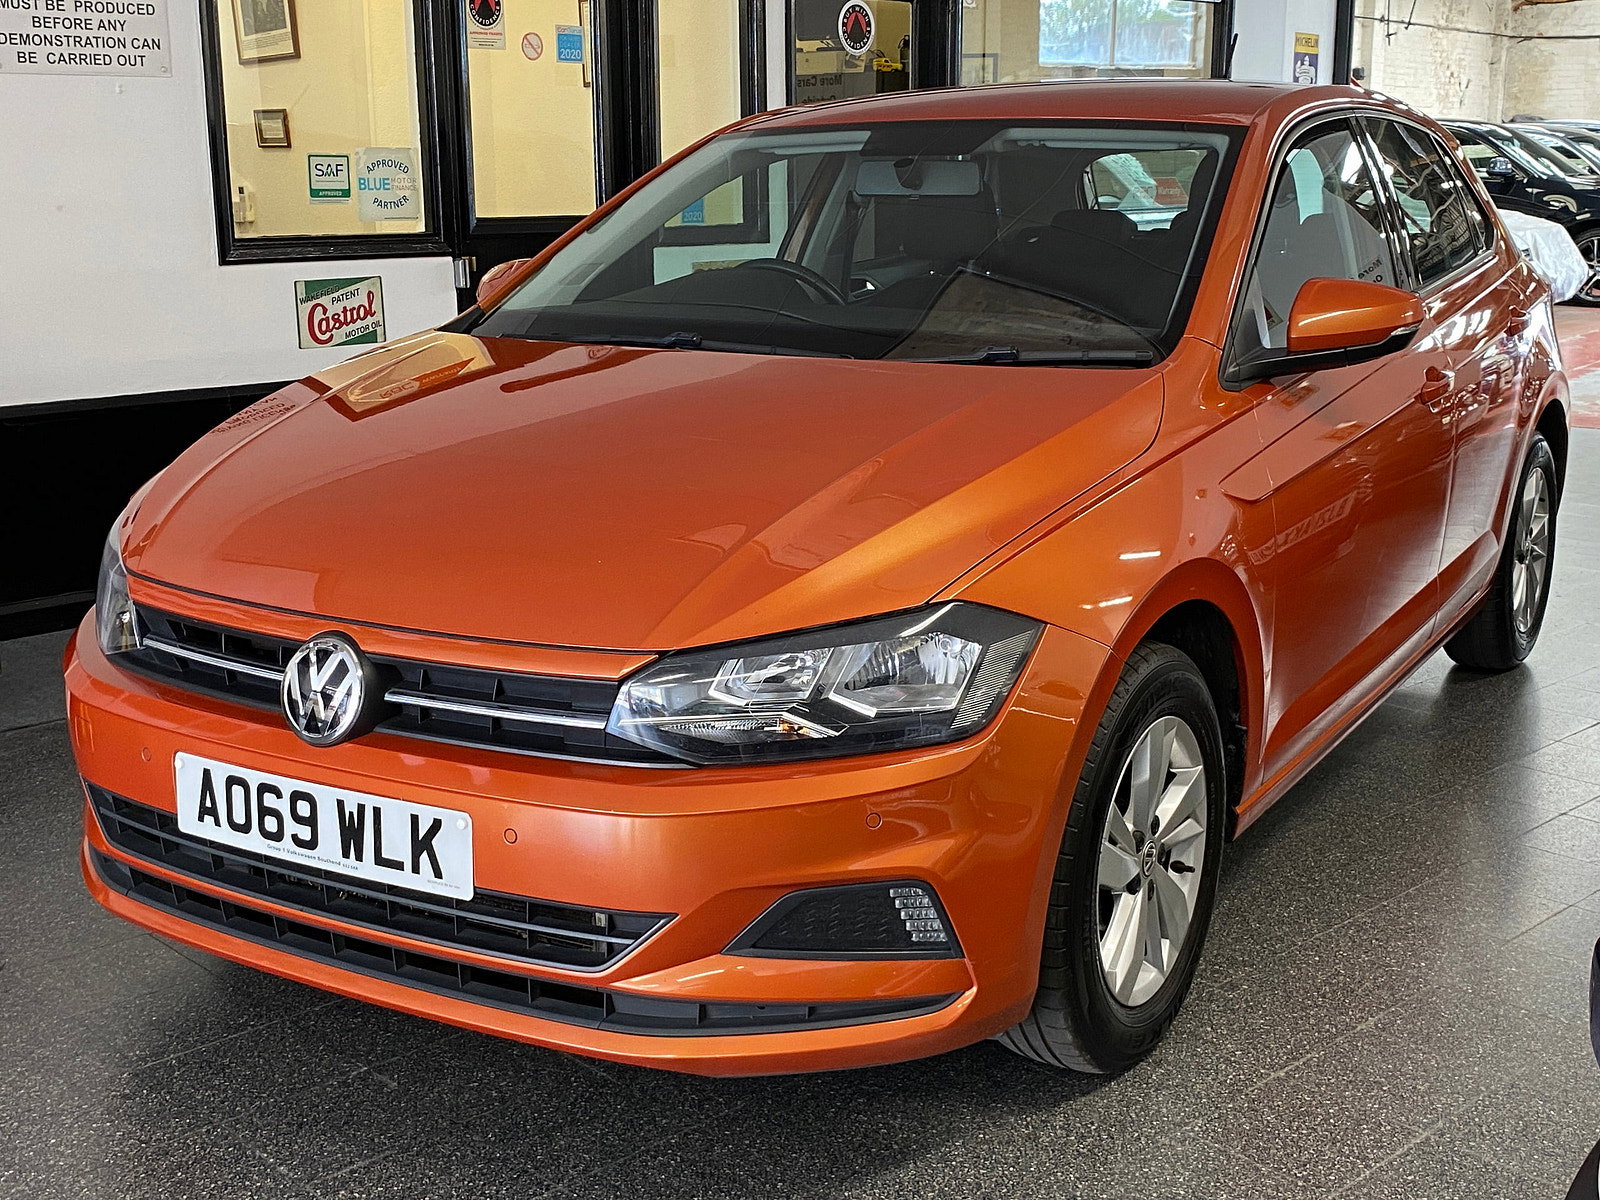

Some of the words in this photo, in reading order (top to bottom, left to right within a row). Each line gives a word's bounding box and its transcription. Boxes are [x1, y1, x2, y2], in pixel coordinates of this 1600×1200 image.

[0, 0, 39, 10] MUST
[45, 0, 66, 12] BE
[75, 1, 156, 16] PRODUCED
[32, 16, 94, 30] BEFORE
[97, 19, 127, 32] ANY
[0, 32, 126, 50] DEMONSTRATION
[131, 38, 161, 50] CAN
[17, 51, 38, 64] BE
[46, 52, 112, 66] CARRIED
[117, 54, 146, 67] OUT
[560, 48, 582, 60] 2020
[314, 163, 344, 177] SAF
[366, 159, 410, 174] APPROVED
[358, 177, 391, 191] BLUE
[373, 194, 410, 210] PARTNER
[683, 211, 703, 222] 2020
[299, 284, 340, 305] WAKEFIELD
[331, 288, 360, 305] PATENT
[307, 290, 376, 345] Castrol
[345, 324, 370, 339] MOTOR
[370, 320, 383, 330] OIL
[336, 798, 443, 880] WLK
[287, 849, 317, 860] Volkswagen
